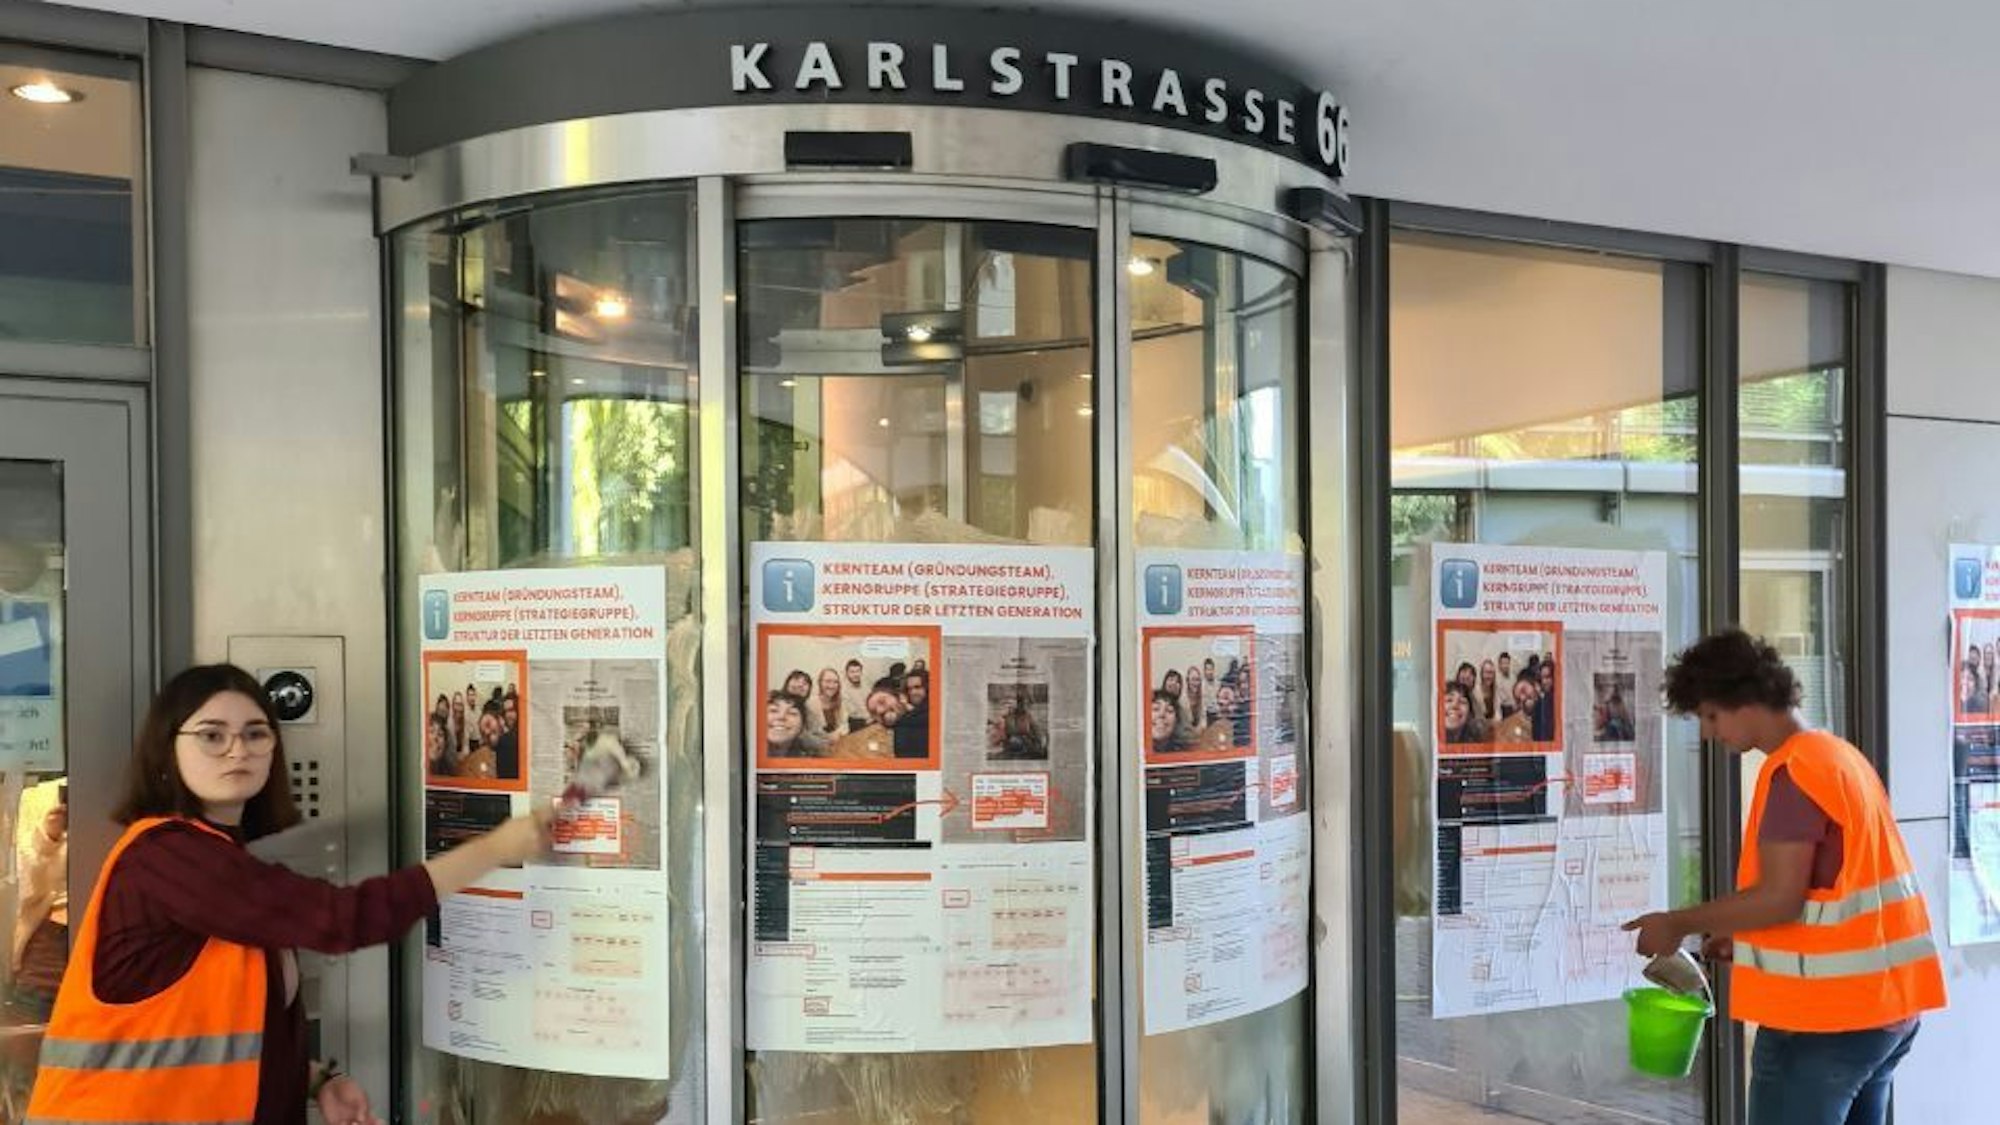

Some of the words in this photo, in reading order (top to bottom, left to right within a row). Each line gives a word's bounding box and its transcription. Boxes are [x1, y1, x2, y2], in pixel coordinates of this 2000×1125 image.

[729, 43, 1296, 144] KARLSTRASSE
[1317, 90, 1350, 177] 66
[822, 563, 903, 576] KERNTEAM
[822, 583, 920, 595] KERNGRUPPE
[823, 604, 900, 616] STRUKTUR
[904, 604, 931, 616] DER
[935, 605, 994, 617] LETZTEN
[997, 605, 1082, 619] GENERATION
[570, 626, 654, 640] GENERATION
